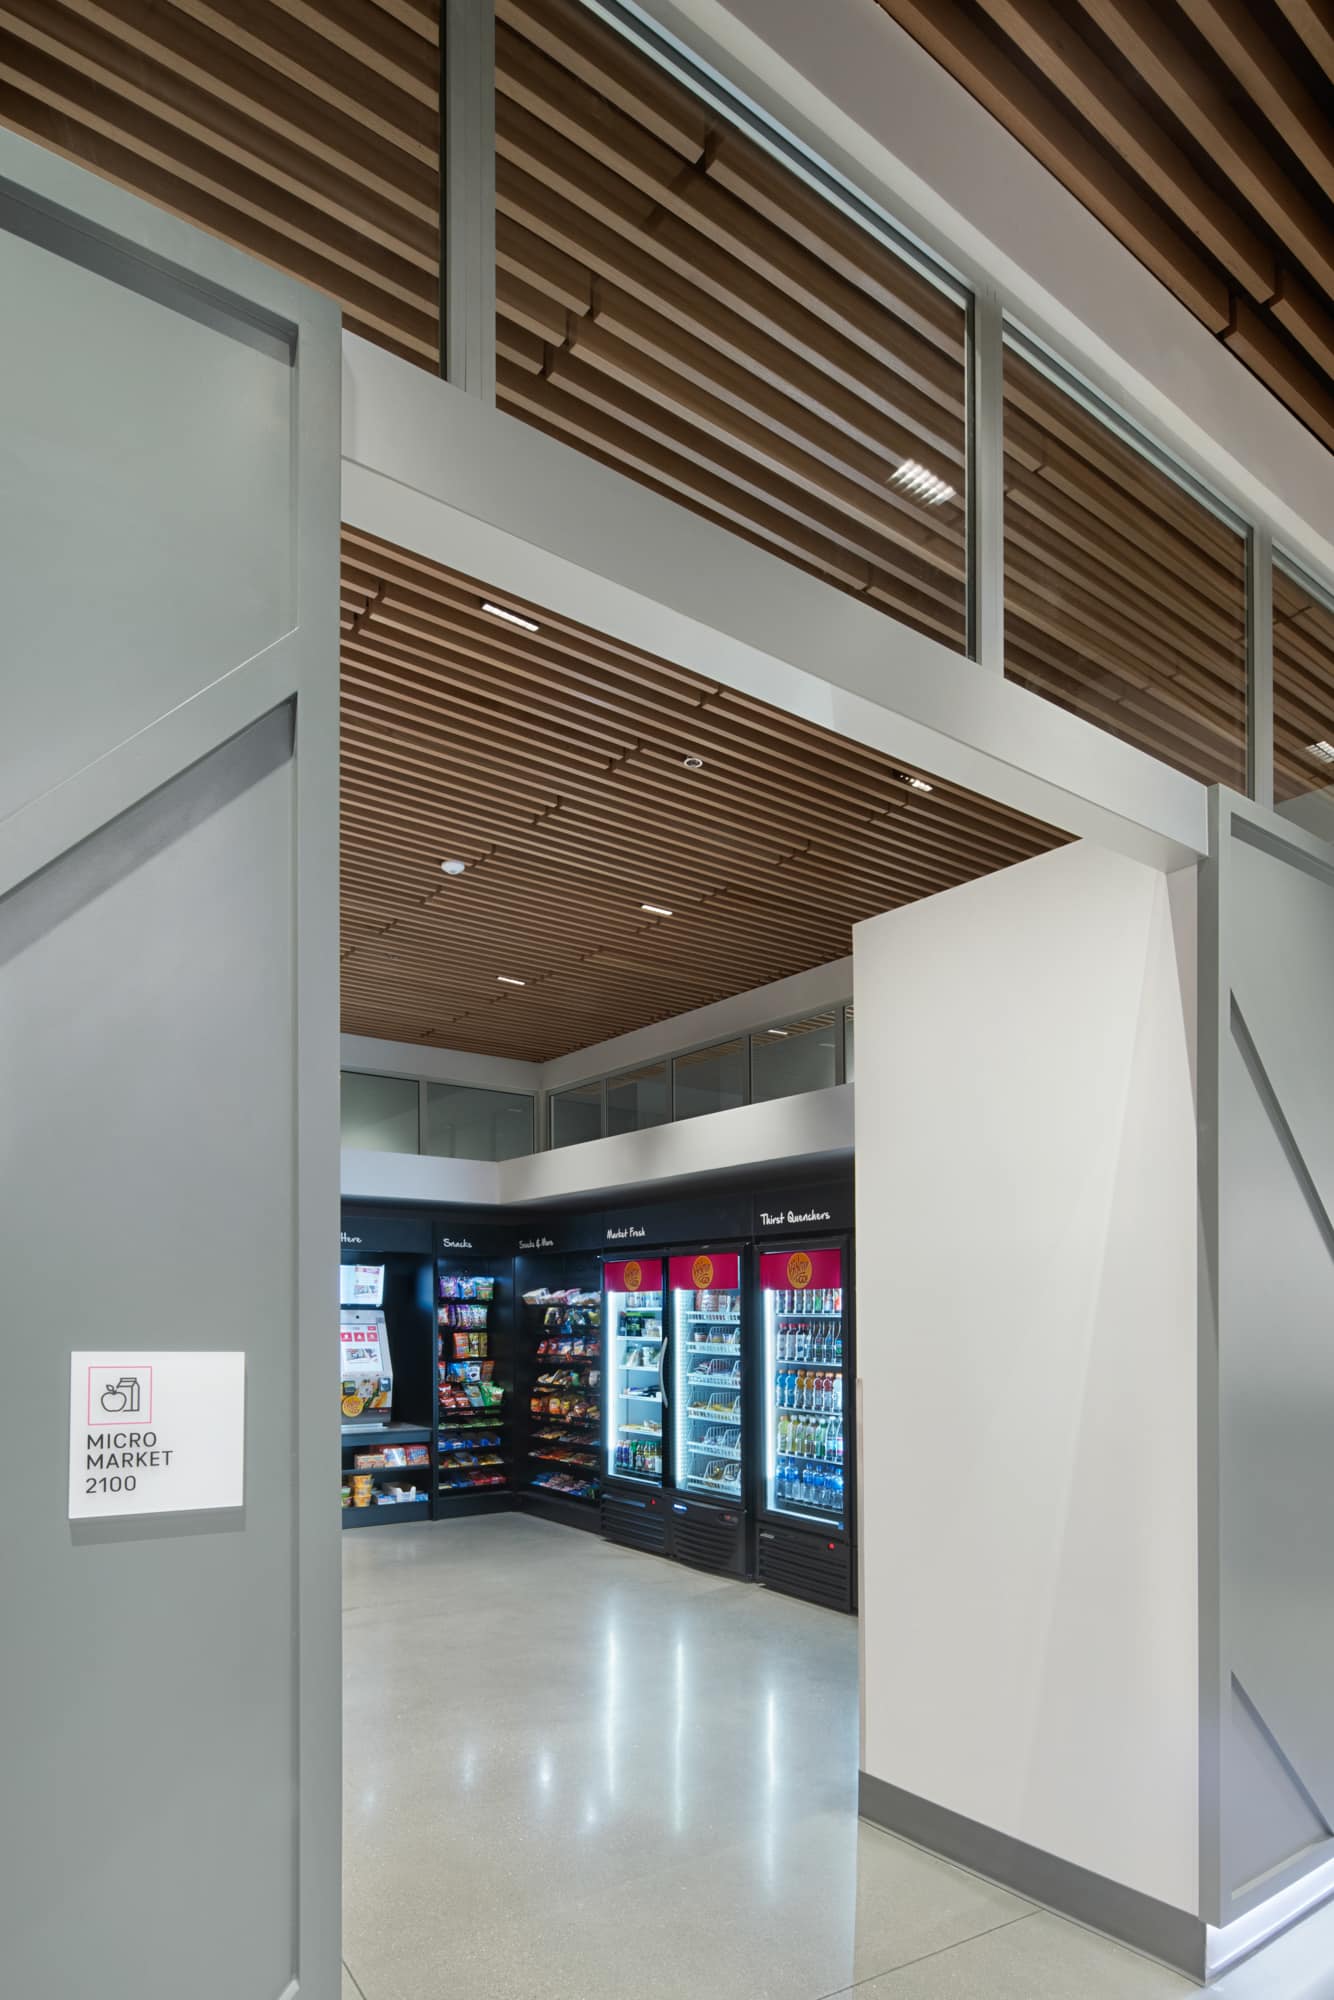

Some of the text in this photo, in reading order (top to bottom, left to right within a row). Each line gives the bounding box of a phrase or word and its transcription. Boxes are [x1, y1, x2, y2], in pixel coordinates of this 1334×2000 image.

[760, 1208, 831, 1226] Thirst Quenchers
[606, 1226, 646, 1240] Market Fresh
[442, 1238, 472, 1249] Snacks
[87, 1432, 157, 1450] MICRO
[87, 1450, 173, 1470] MARKET
[86, 1475, 137, 1494] 2100
